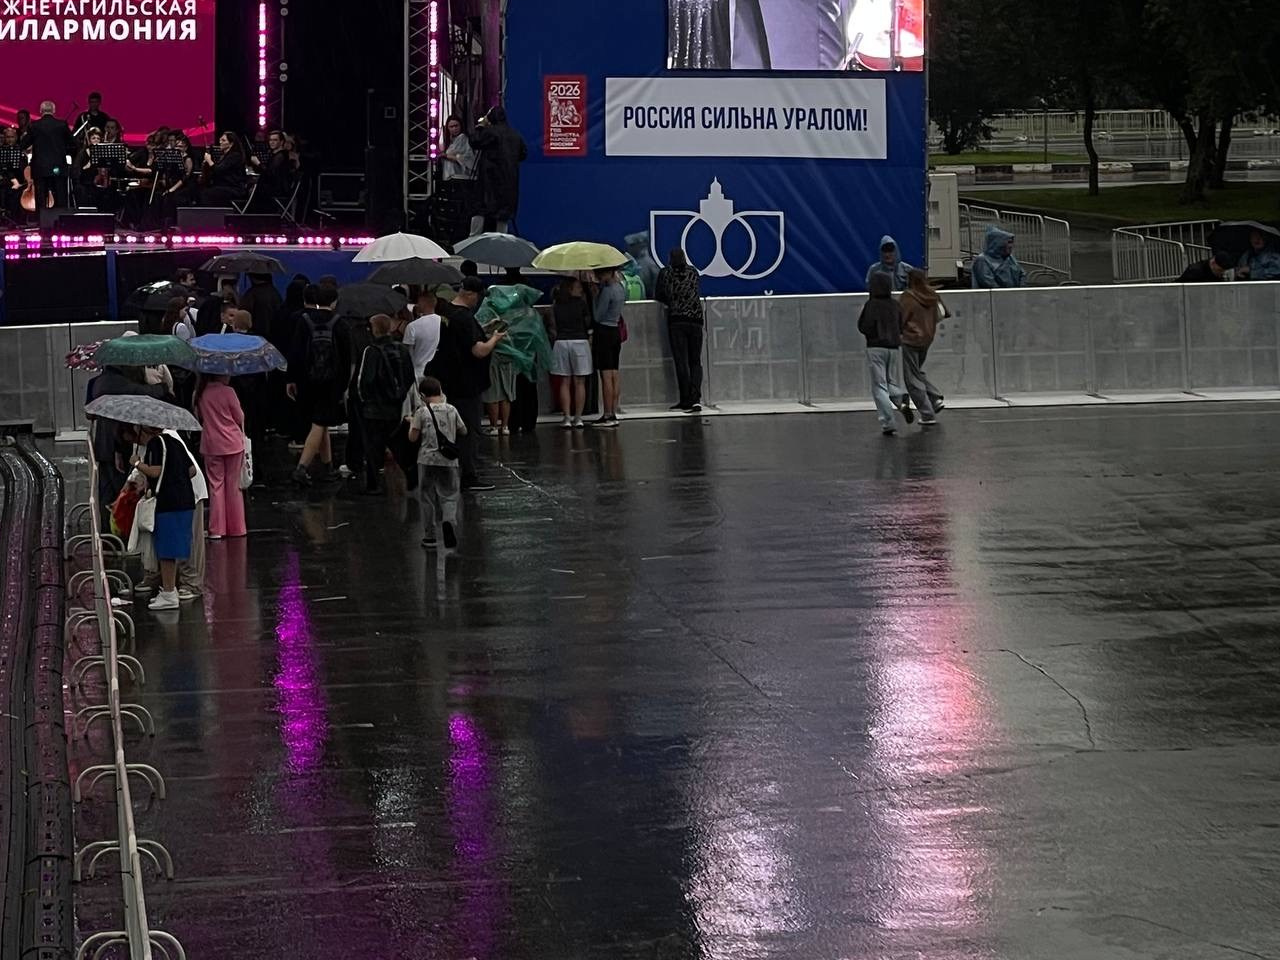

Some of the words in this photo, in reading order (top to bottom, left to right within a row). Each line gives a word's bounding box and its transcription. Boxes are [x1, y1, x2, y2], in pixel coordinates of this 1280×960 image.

[550, 84, 580, 96] 2026
[623, 105, 696, 129] РОССИЯ
[701, 106, 778, 130] СИЛЬНА
[782, 107, 868, 132] УРАЛОМ!
